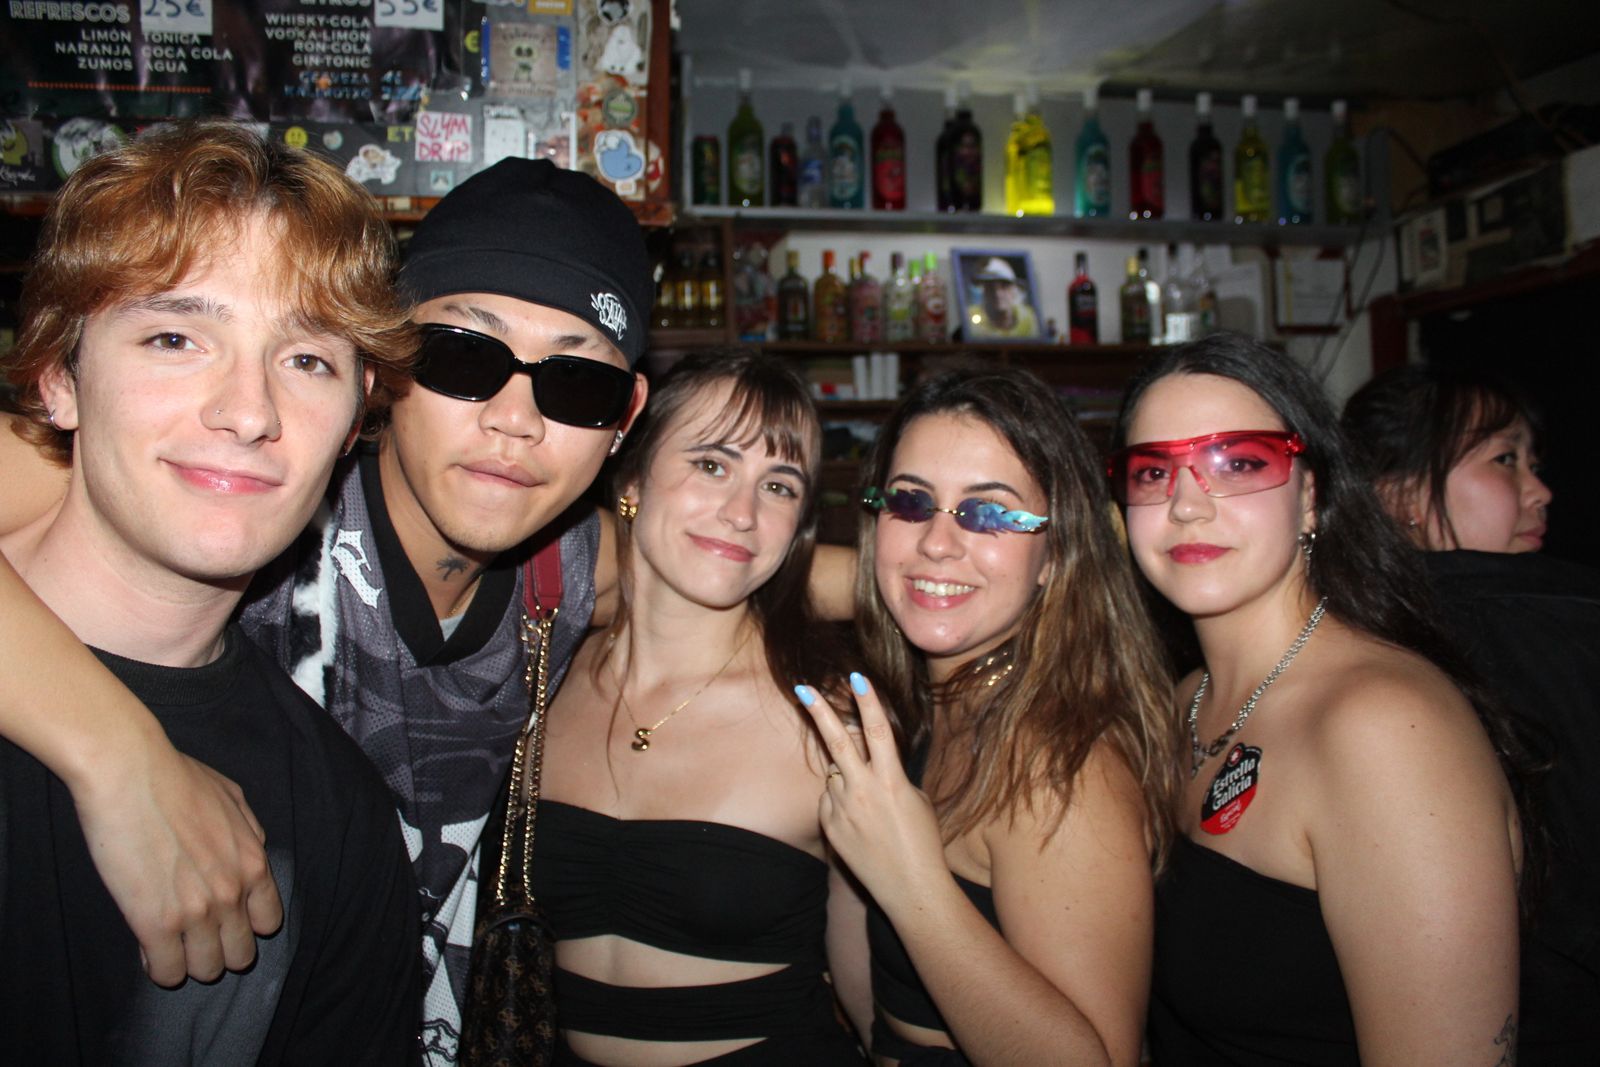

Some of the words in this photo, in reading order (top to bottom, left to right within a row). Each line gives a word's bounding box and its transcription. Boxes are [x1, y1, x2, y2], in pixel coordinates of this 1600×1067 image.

[10, 0, 131, 23] REFRESCOS
[55, 42, 131, 56] NARANJA
[141, 45, 186, 59] COCA
[190, 47, 233, 60] COLA
[78, 58, 133, 70] ZUMOS
[144, 60, 188, 73] AGUA
[1213, 758, 1256, 796] Estrella
[1212, 775, 1252, 811] Galicia
